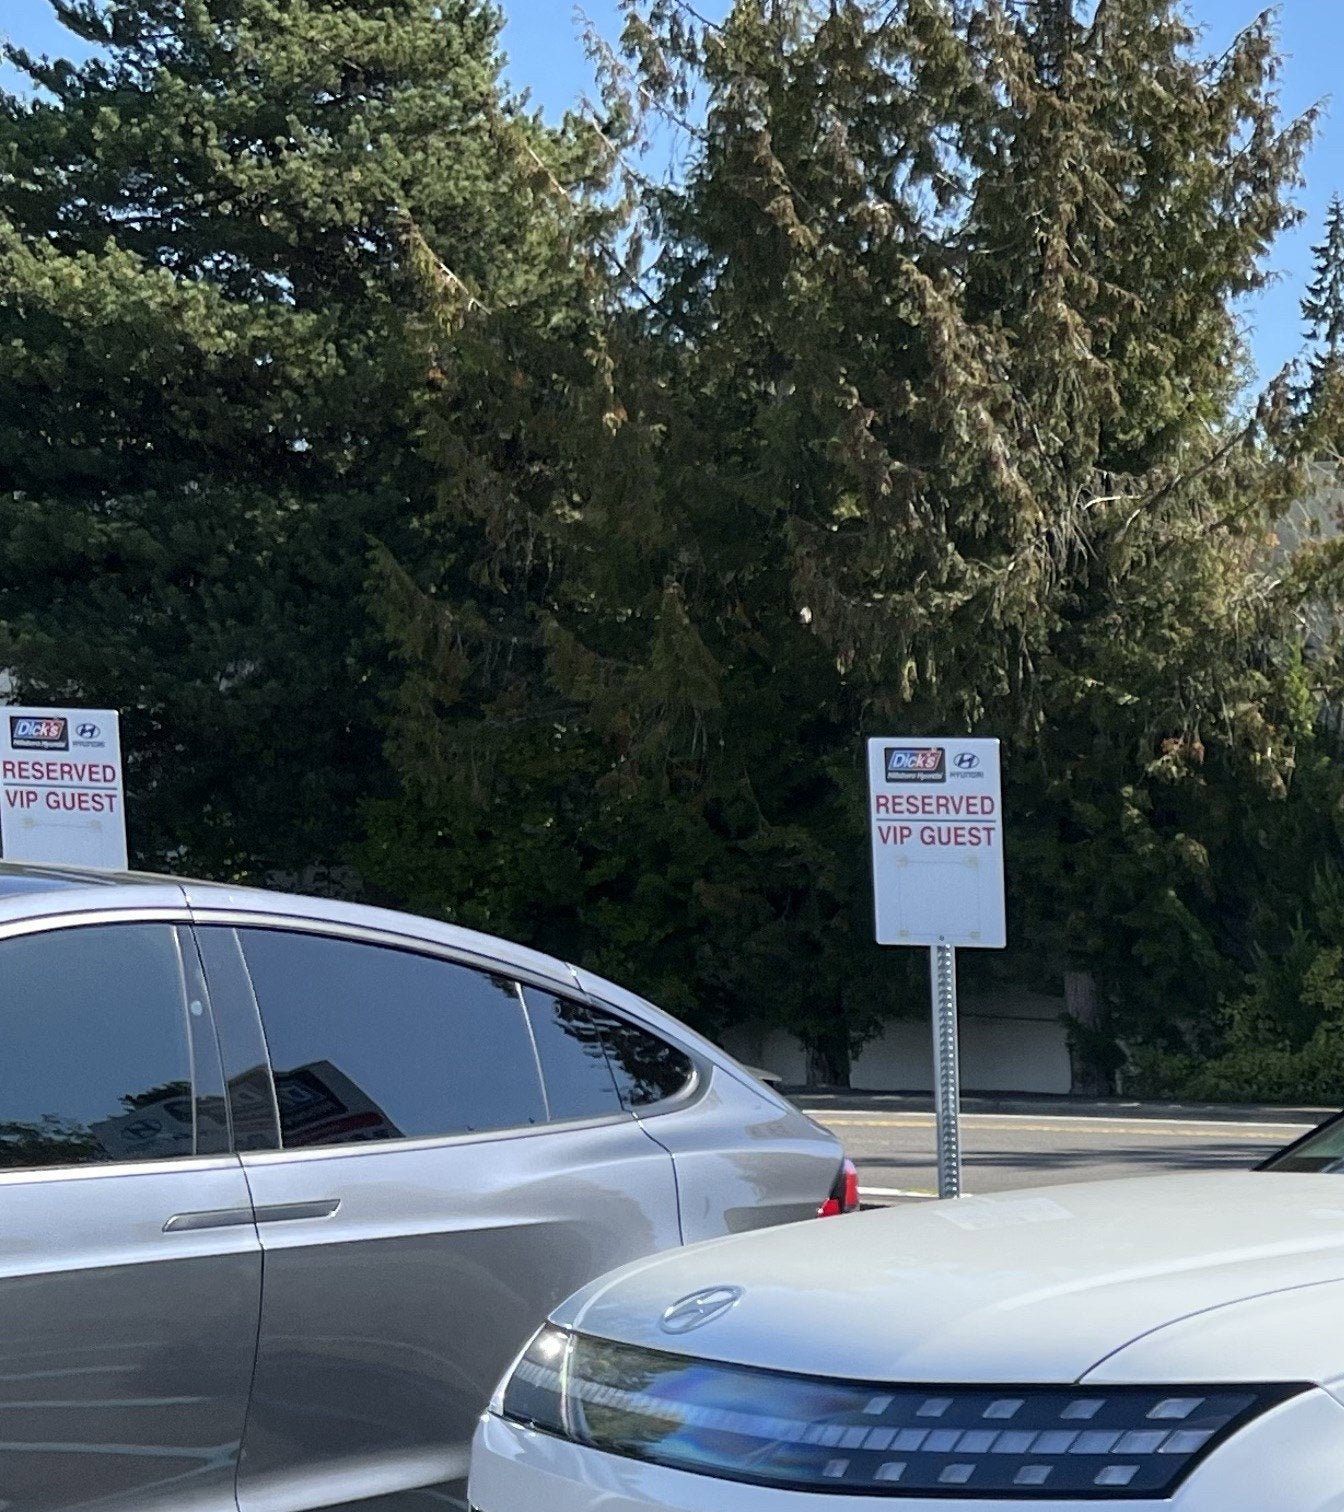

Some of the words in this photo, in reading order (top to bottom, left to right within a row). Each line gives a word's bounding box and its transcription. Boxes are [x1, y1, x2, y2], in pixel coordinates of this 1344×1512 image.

[2, 761, 116, 783] RESERVED
[5, 790, 38, 809] VIP
[46, 791, 118, 813] GUEST
[876, 795, 995, 815] RESERVED
[878, 826, 913, 845] VIP
[920, 826, 996, 846] GUEST
